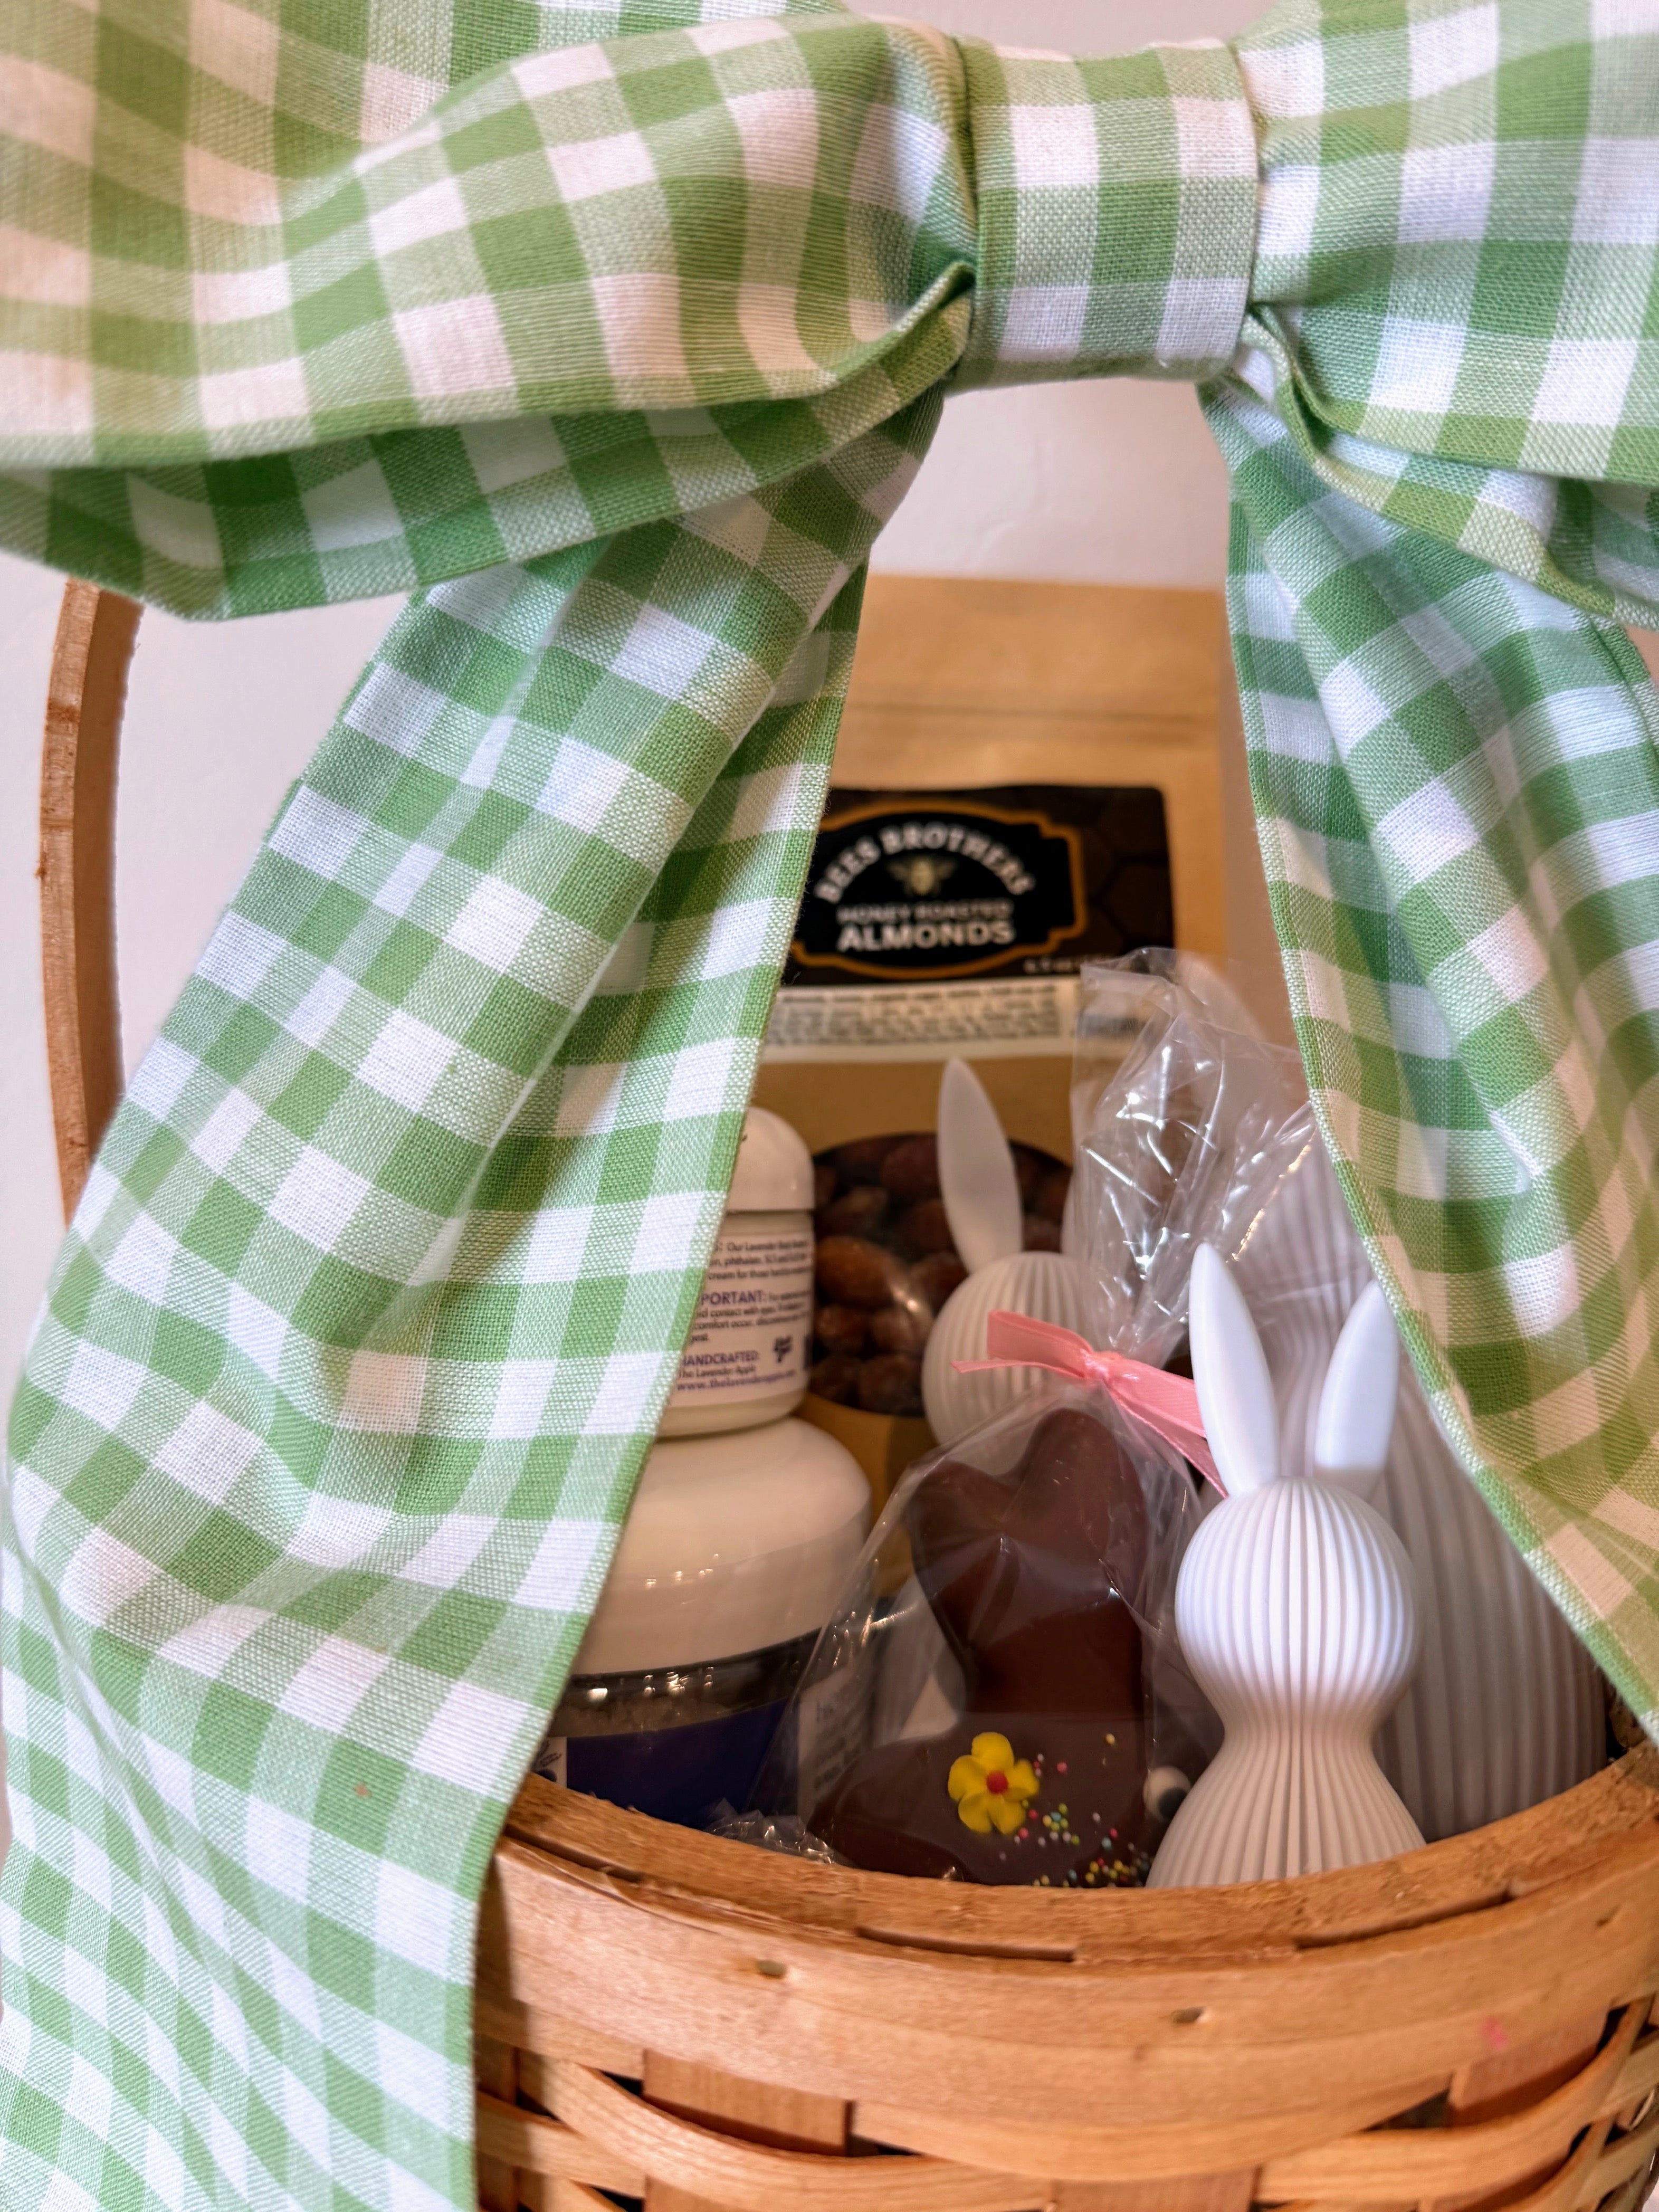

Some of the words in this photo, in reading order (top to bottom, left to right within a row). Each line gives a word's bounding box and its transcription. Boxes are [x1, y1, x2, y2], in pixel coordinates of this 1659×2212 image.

[814, 836, 881, 903] BEES
[879, 822, 1035, 895] BROTHERS
[837, 921, 1016, 951] ALMONDS
